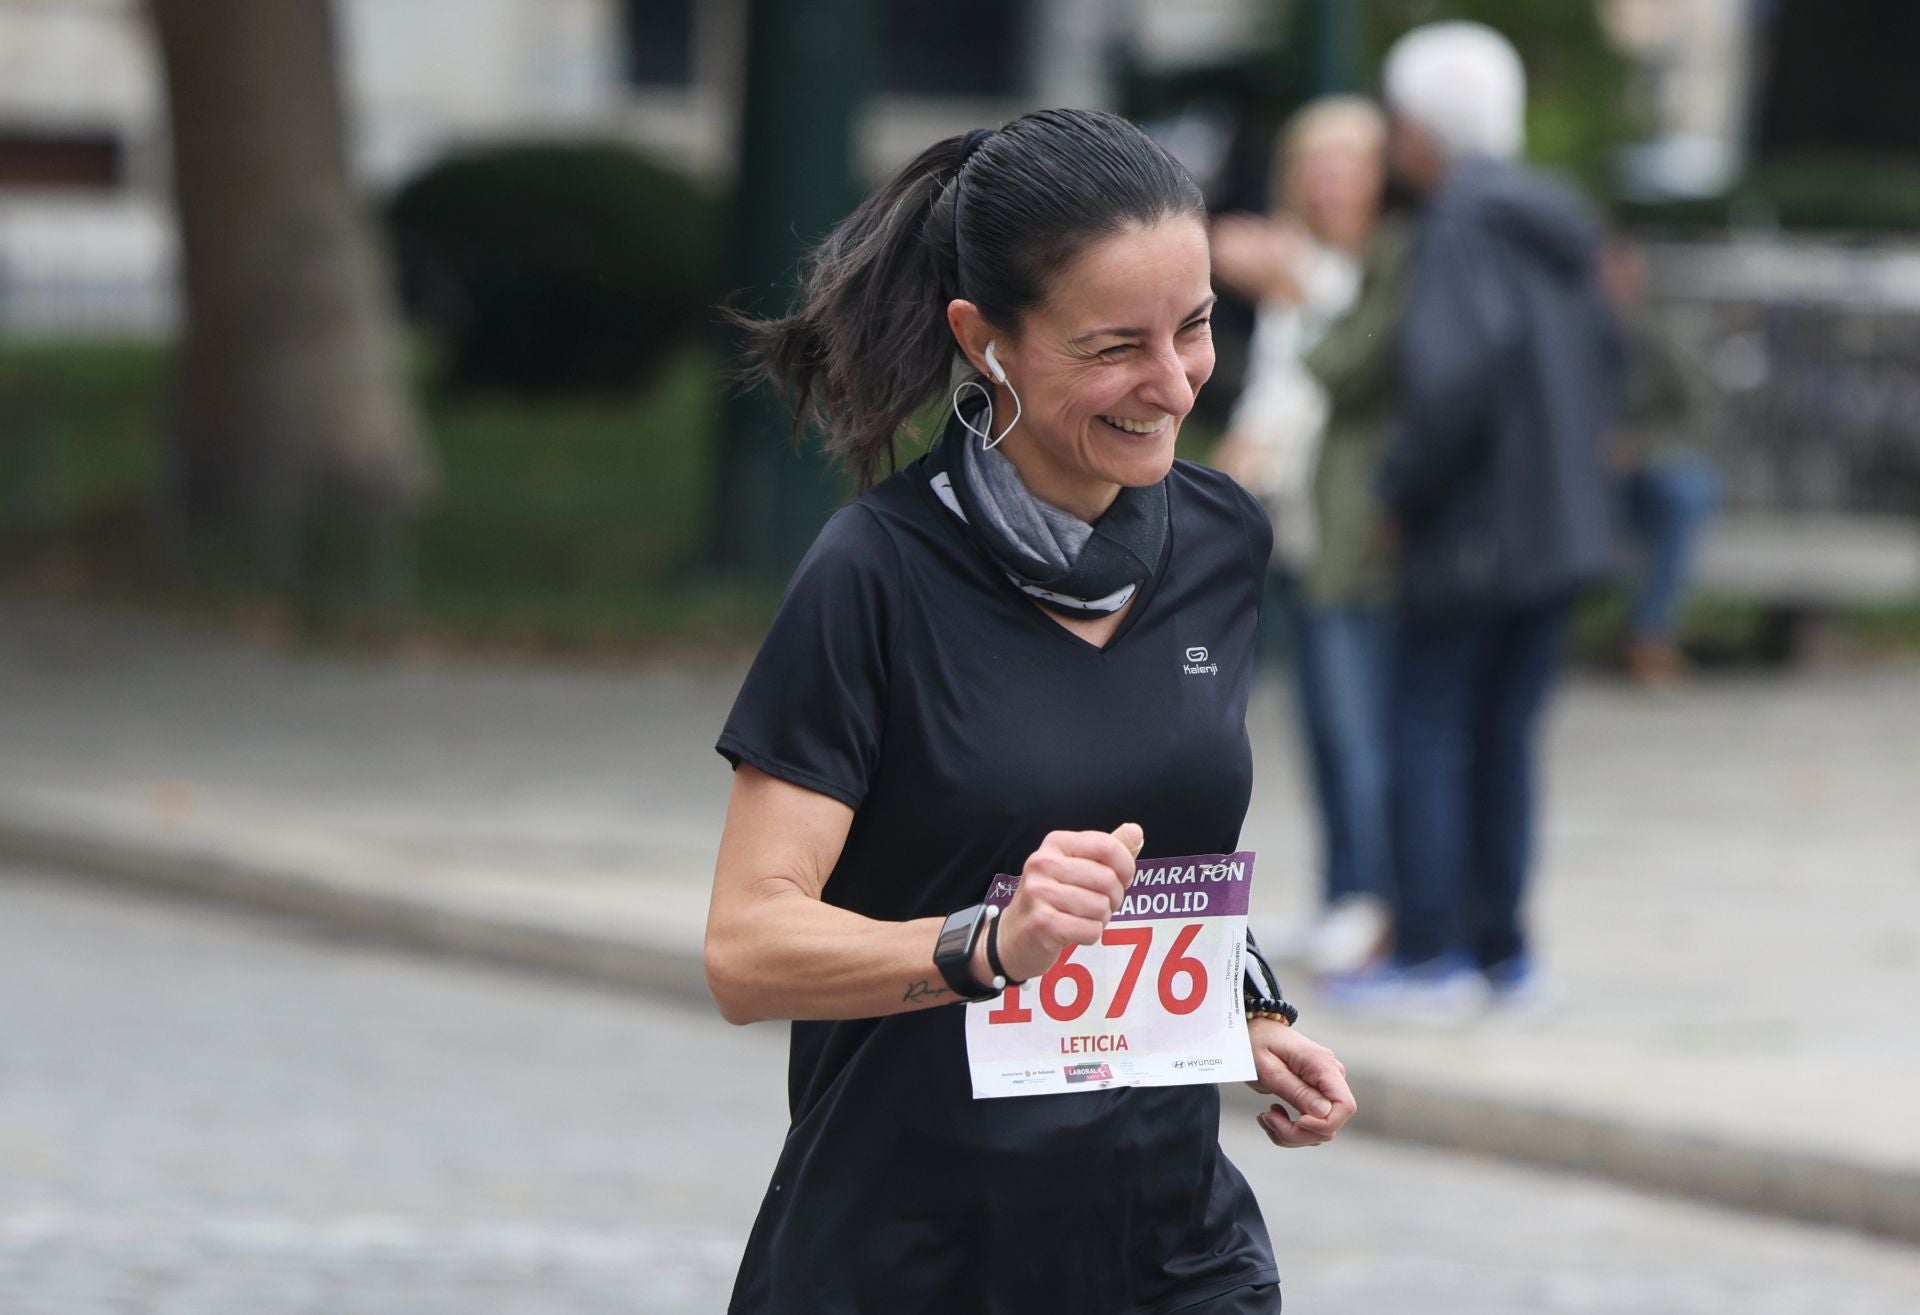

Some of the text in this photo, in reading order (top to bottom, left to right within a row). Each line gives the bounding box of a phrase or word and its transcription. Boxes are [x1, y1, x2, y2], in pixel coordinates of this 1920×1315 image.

[1183, 663, 1218, 676] Kalenji
[1132, 859, 1245, 887] MARATÓN
[1112, 891, 1209, 916] ADOLID
[1061, 1034, 1129, 1054] LETICIA
[1187, 1058, 1223, 1067] HYUNDAI
[1068, 1068, 1098, 1076] LABORAL
